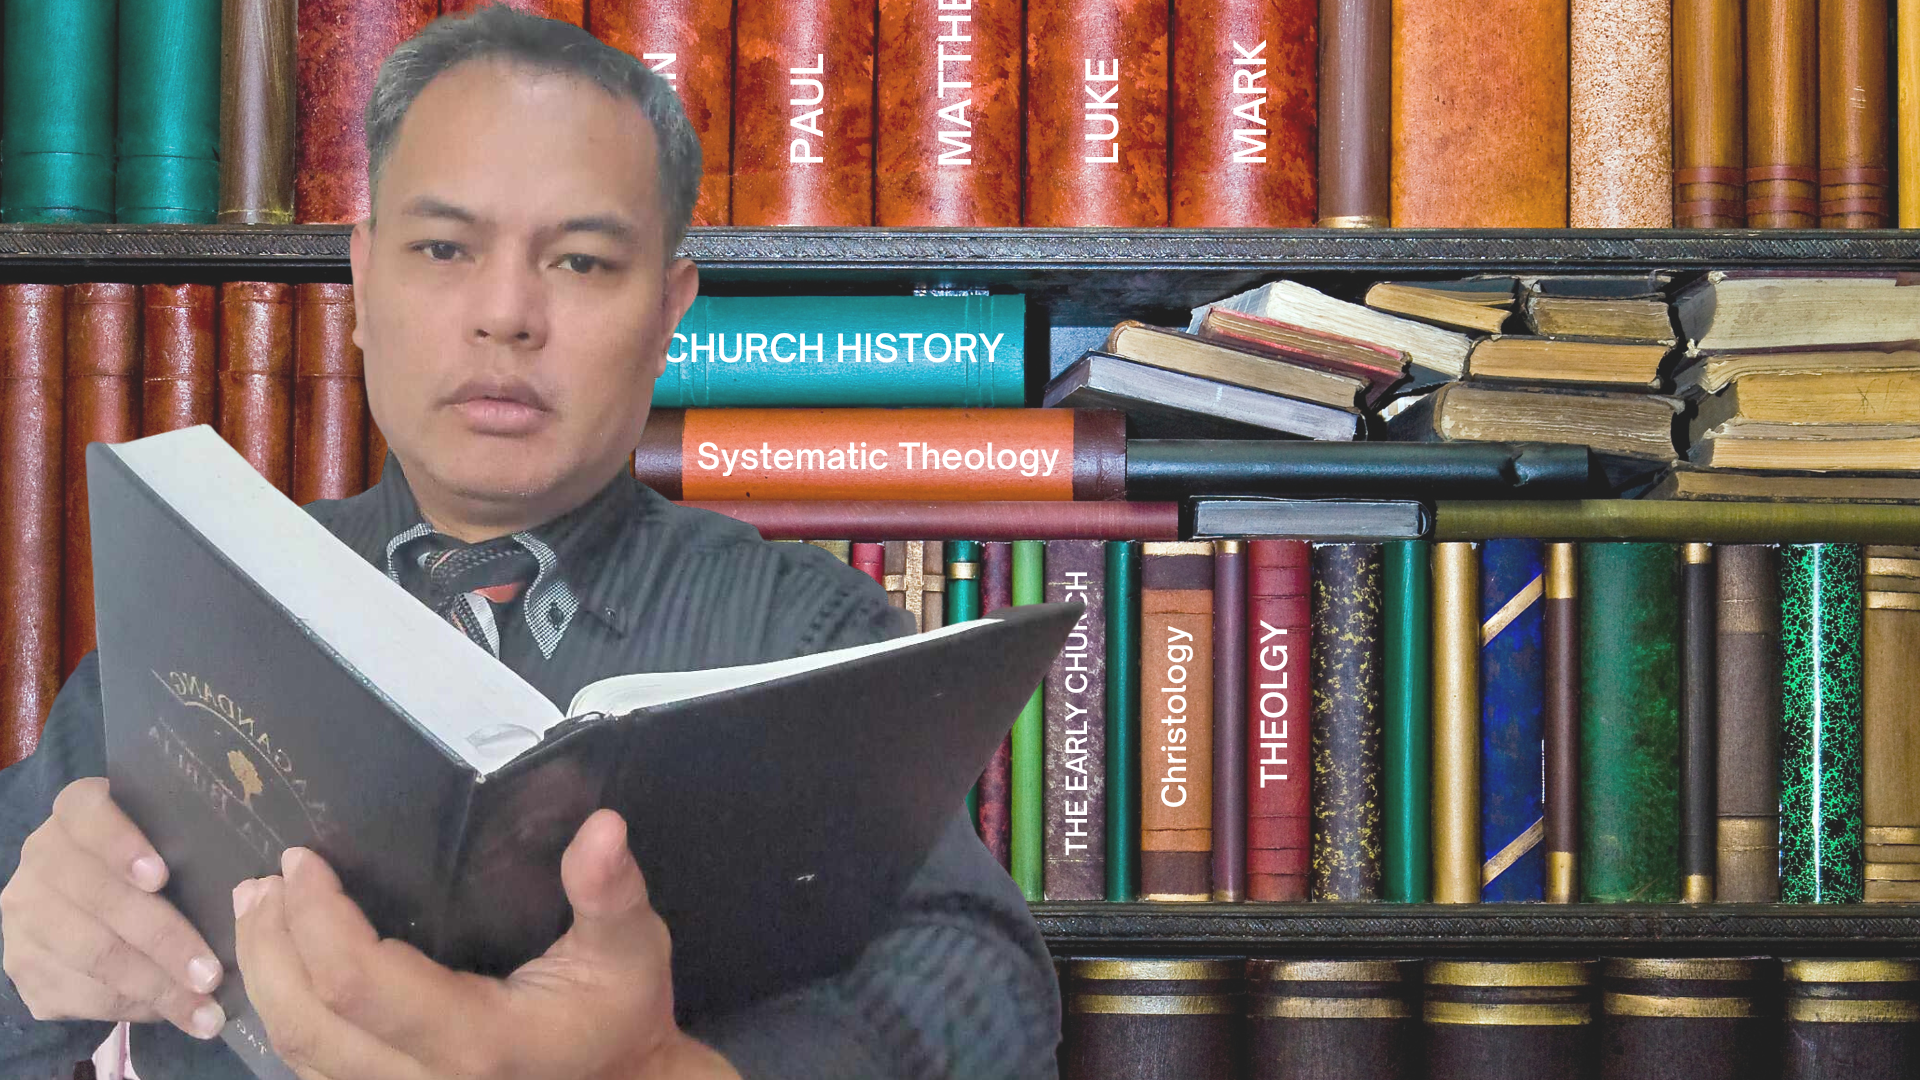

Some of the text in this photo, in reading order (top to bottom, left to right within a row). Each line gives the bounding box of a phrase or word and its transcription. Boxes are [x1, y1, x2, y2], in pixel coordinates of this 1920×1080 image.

[790, 53, 824, 164] PAUL
[1084, 58, 1119, 164] LUKE
[1232, 39, 1267, 164] MARK
[666, 332, 1004, 363] CHURCH HISTORY
[697, 441, 1060, 477] Systematic Theology
[1065, 701, 1088, 791] EARLY
[1160, 625, 1194, 808] Christology
[1259, 620, 1288, 789] THEOLGY
[1065, 800, 1088, 856] THE
